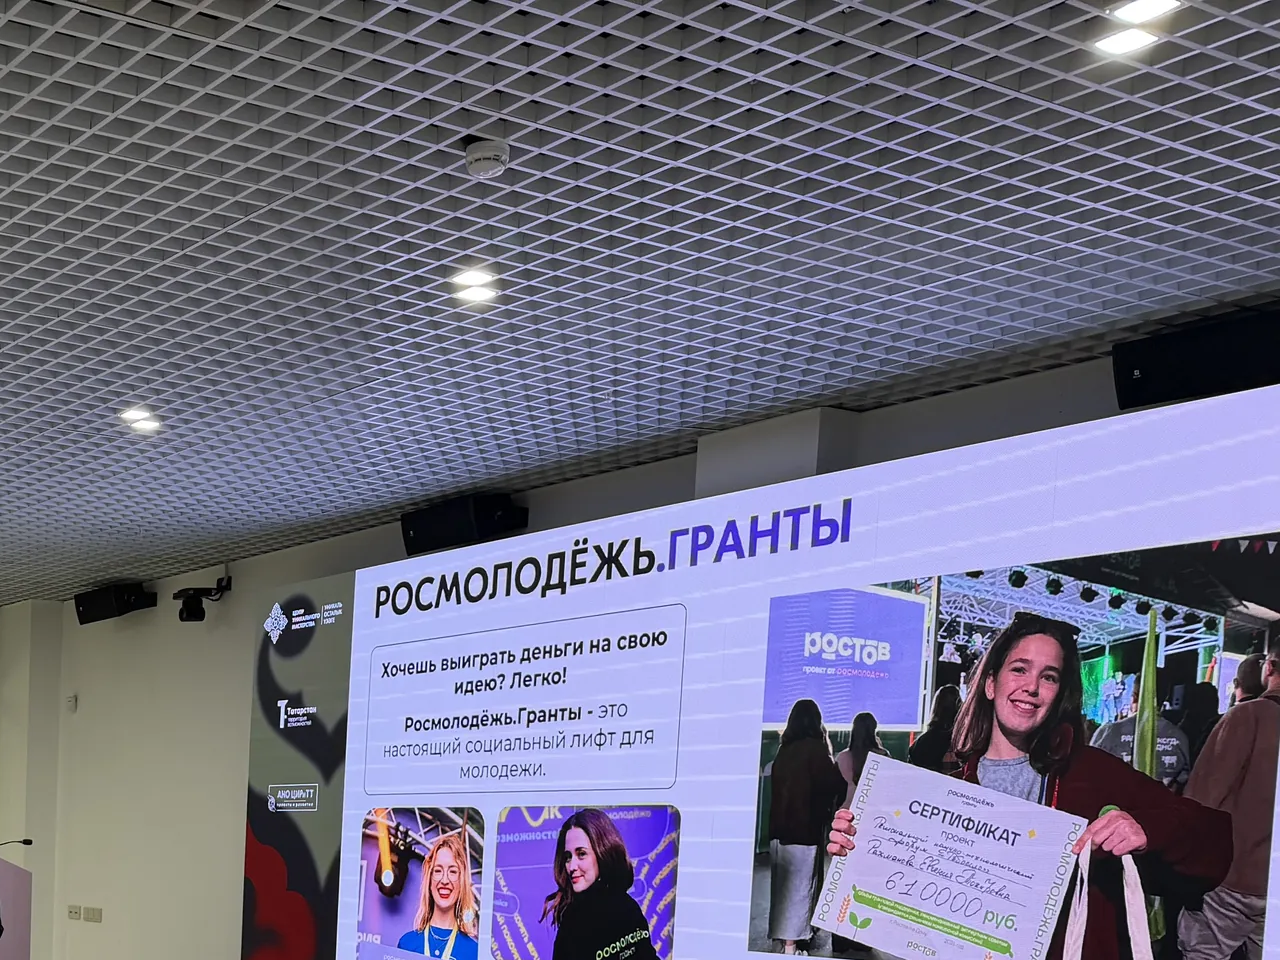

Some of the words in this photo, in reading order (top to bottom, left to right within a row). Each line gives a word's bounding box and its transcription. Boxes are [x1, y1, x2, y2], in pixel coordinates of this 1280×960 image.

[374, 497, 853, 618] РОСМОЛОДЁЖЬ.ГРАНТЫ
[381, 656, 437, 679] Хочешь
[440, 650, 516, 672] выиграть
[520, 641, 584, 665] деньги
[589, 639, 612, 654] на
[617, 630, 668, 650] свою
[453, 674, 506, 696] идею?
[509, 666, 568, 689] Легко!
[404, 704, 582, 733] Росмолодёжь.Гранты
[597, 702, 629, 719] это
[382, 735, 462, 760] настоящий
[465, 730, 566, 756] социальный
[570, 727, 617, 751] лифт
[619, 727, 655, 750] для
[459, 762, 547, 781] молодежи.
[908, 799, 1022, 847] СЕРТИФИКАТ
[940, 830, 976, 848] проект
[982, 907, 1018, 932] руб.
